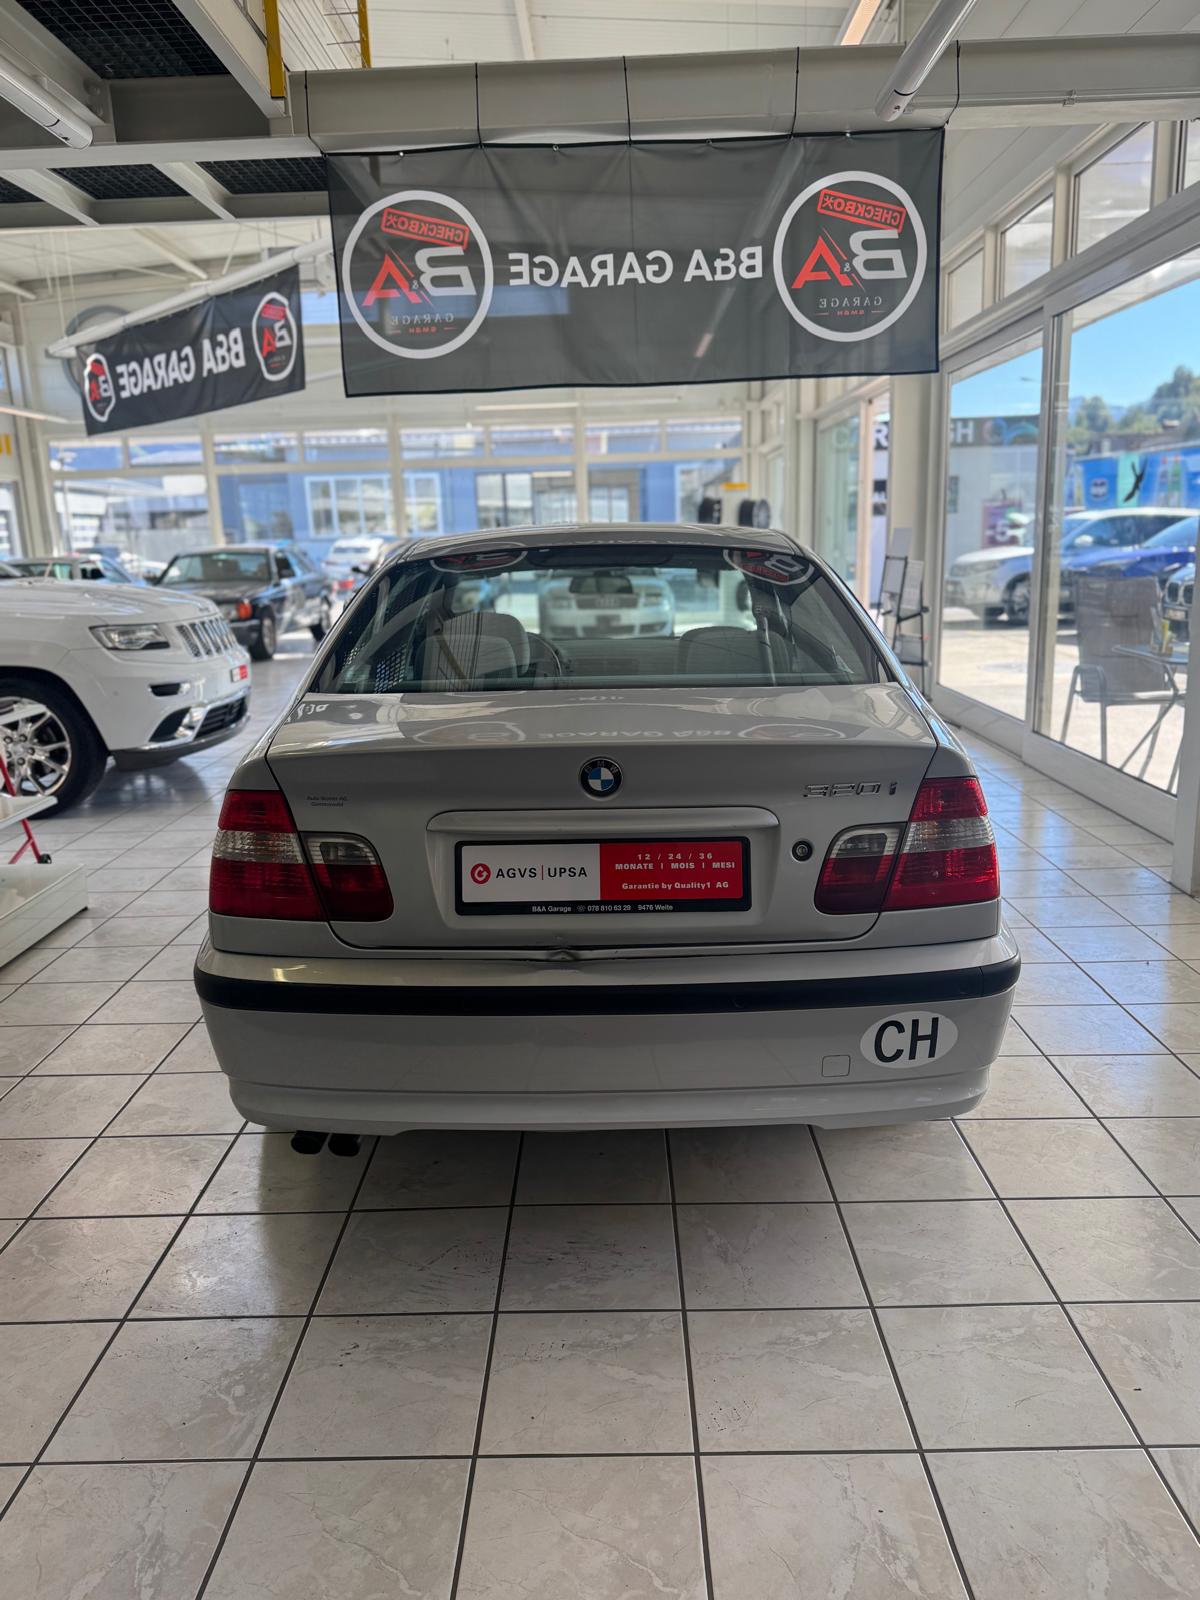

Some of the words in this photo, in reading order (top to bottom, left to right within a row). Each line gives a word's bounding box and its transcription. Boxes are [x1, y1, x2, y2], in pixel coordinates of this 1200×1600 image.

[699, 852, 713, 860] 36
[495, 867, 537, 878] AGVS
[547, 866, 588, 878] UPSA
[661, 882, 672, 890] by
[674, 882, 711, 890] Quality1
[873, 1016, 940, 1063] CH
